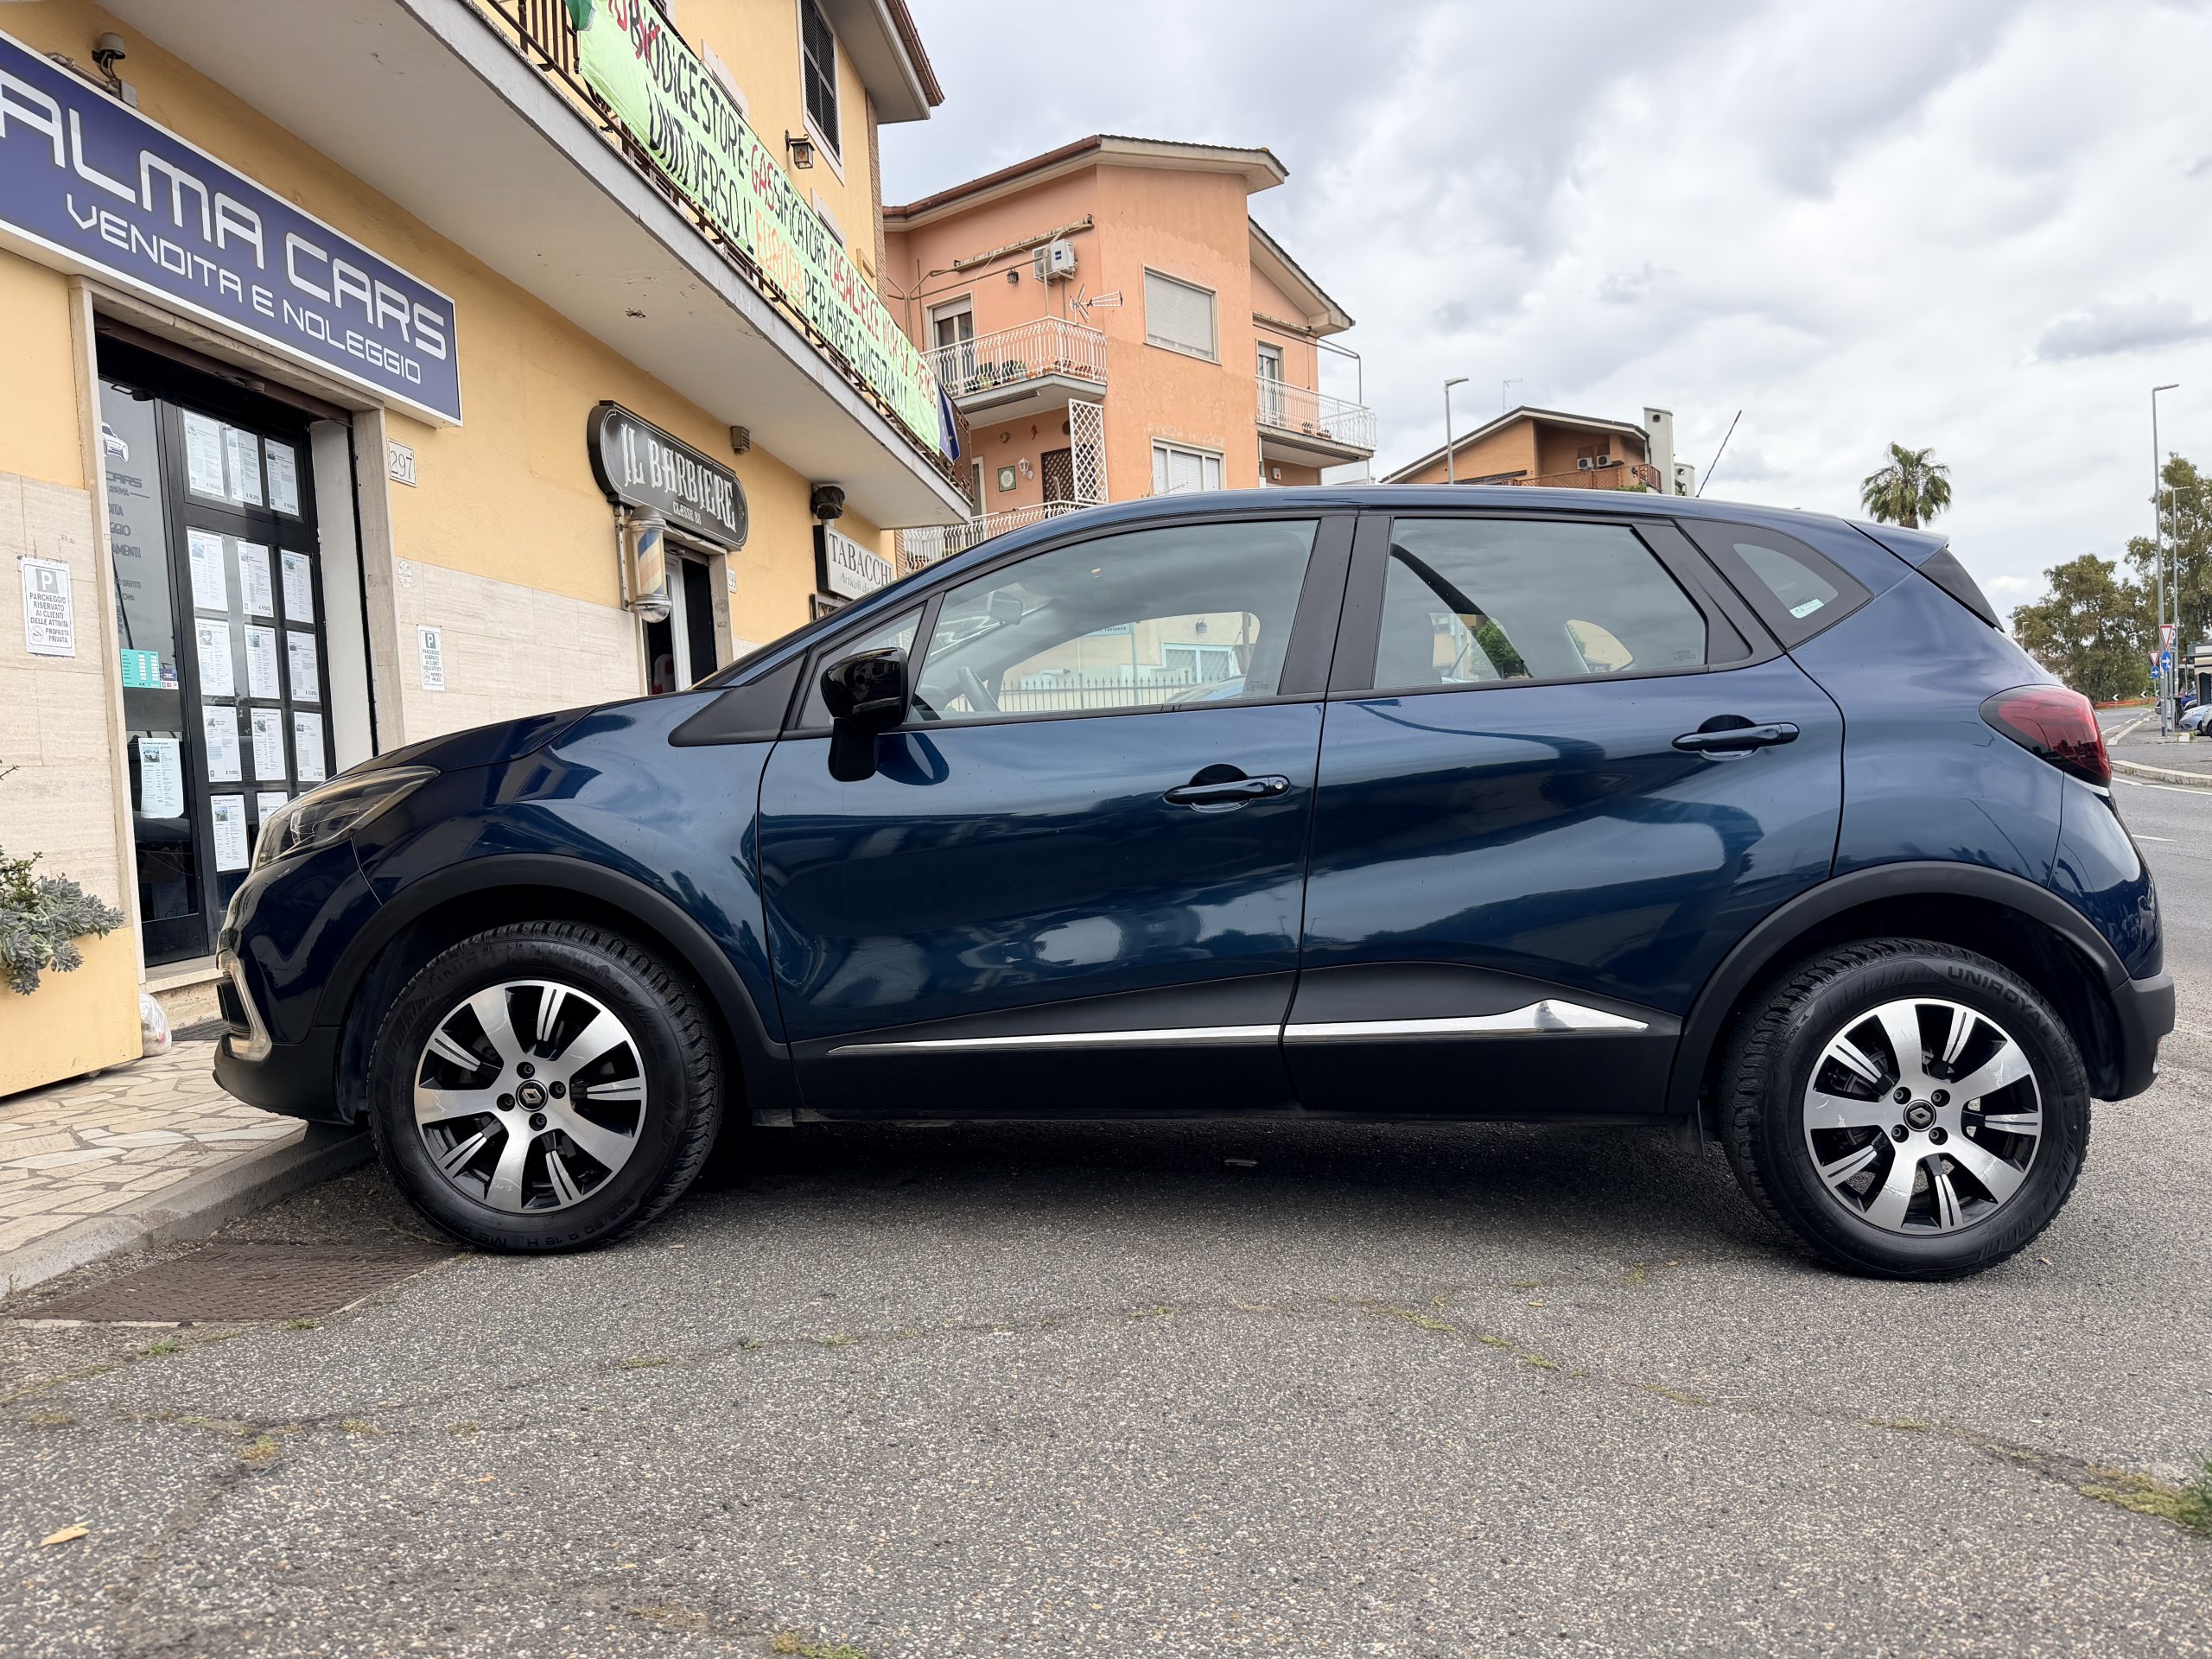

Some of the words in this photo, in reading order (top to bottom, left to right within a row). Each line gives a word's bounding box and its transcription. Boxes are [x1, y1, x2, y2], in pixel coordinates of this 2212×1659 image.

[67, 193, 242, 303] VENDITA
[252, 284, 275, 317] E
[283, 299, 421, 385] NOLEGGIO
[286, 232, 447, 360] CARS
[390, 450, 413, 480] 297
[621, 423, 645, 487] IL
[648, 438, 736, 533] BARBIERE
[829, 533, 892, 587] TABACCHI
[29, 592, 67, 605] PARCHEGGIO
[33, 601, 65, 612] RISERVATO
[43, 610, 64, 620] CLIENTI
[30, 616, 48, 626] DELLE
[1947, 964, 2050, 1034] UNIROYAL
